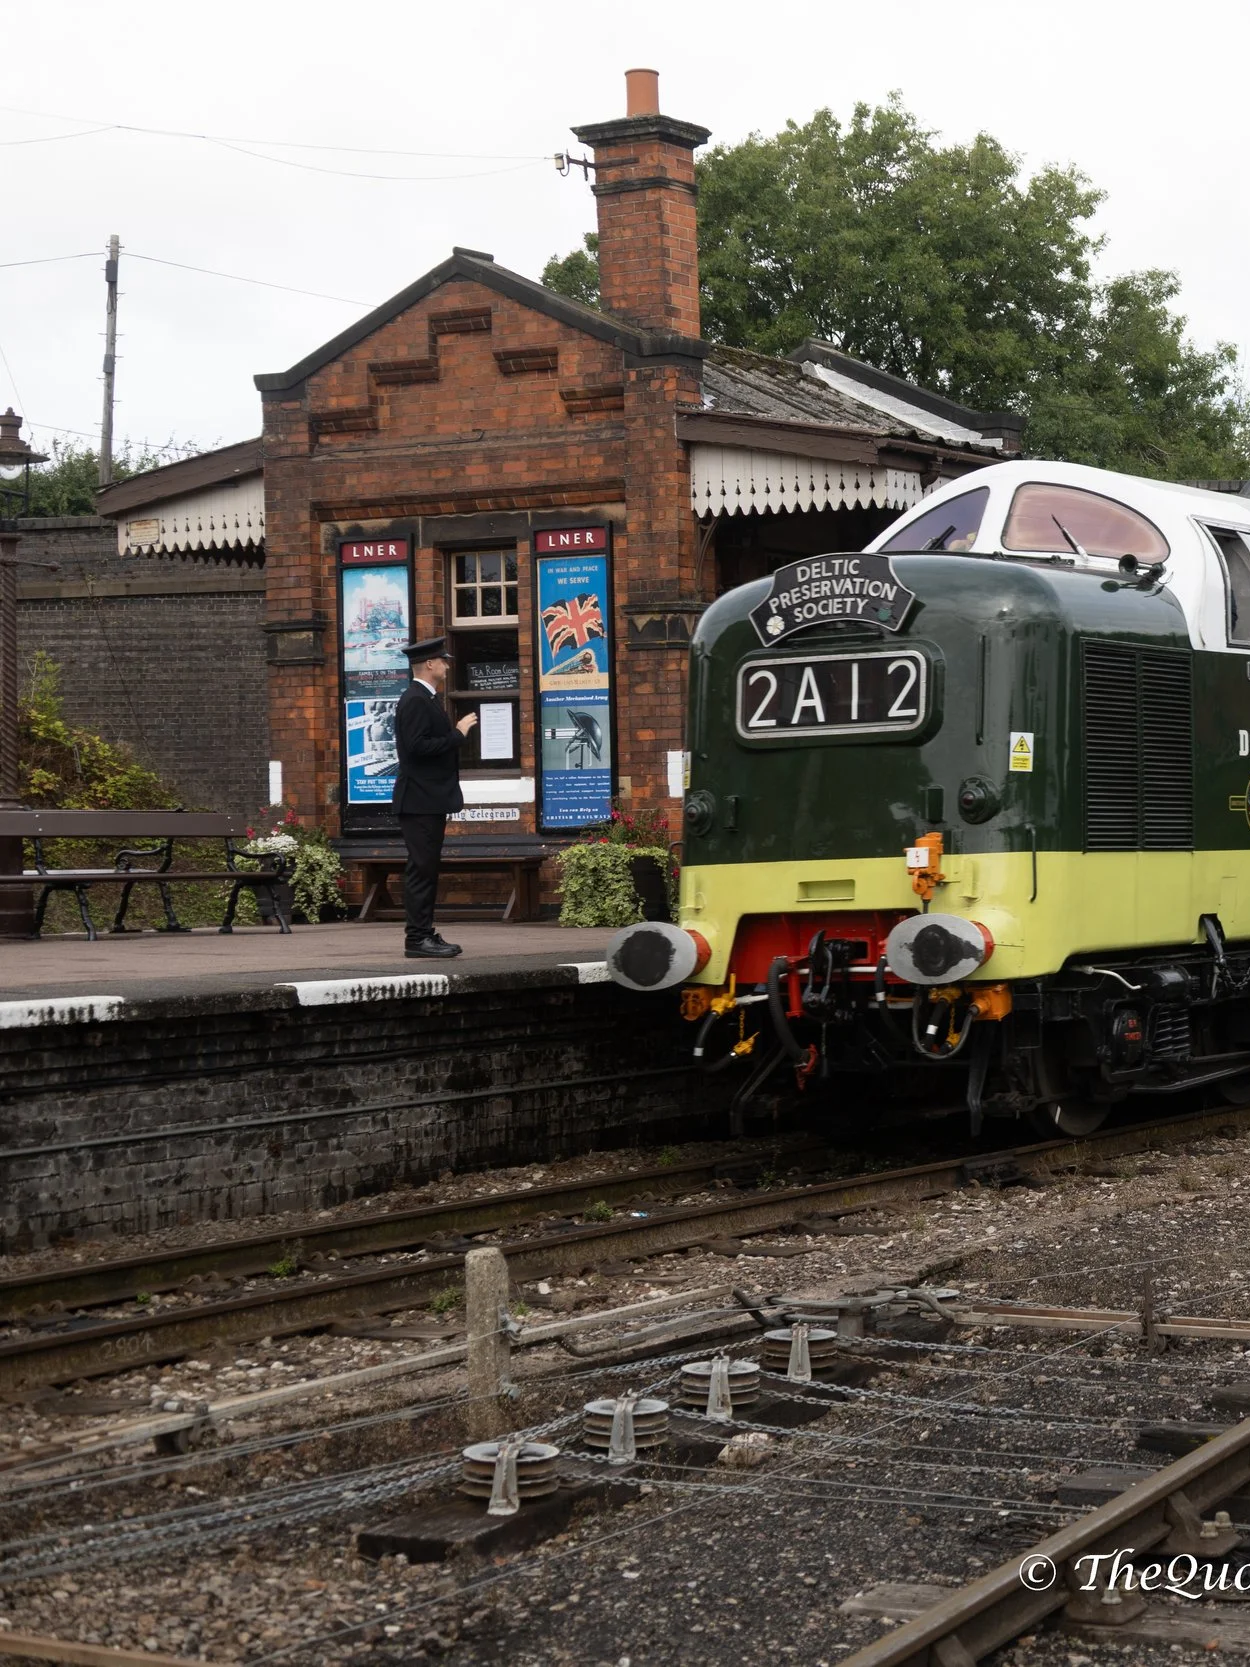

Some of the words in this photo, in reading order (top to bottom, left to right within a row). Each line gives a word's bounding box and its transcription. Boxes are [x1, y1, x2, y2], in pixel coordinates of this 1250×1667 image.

[353, 544, 397, 557] LNER
[548, 532, 594, 546] LNER
[796, 559, 861, 582] DELTIC
[768, 578, 898, 614] PRESERVATION
[793, 598, 868, 622] SOCIETY
[748, 658, 918, 728] 2A12
[470, 809, 517, 820] Telegraph
